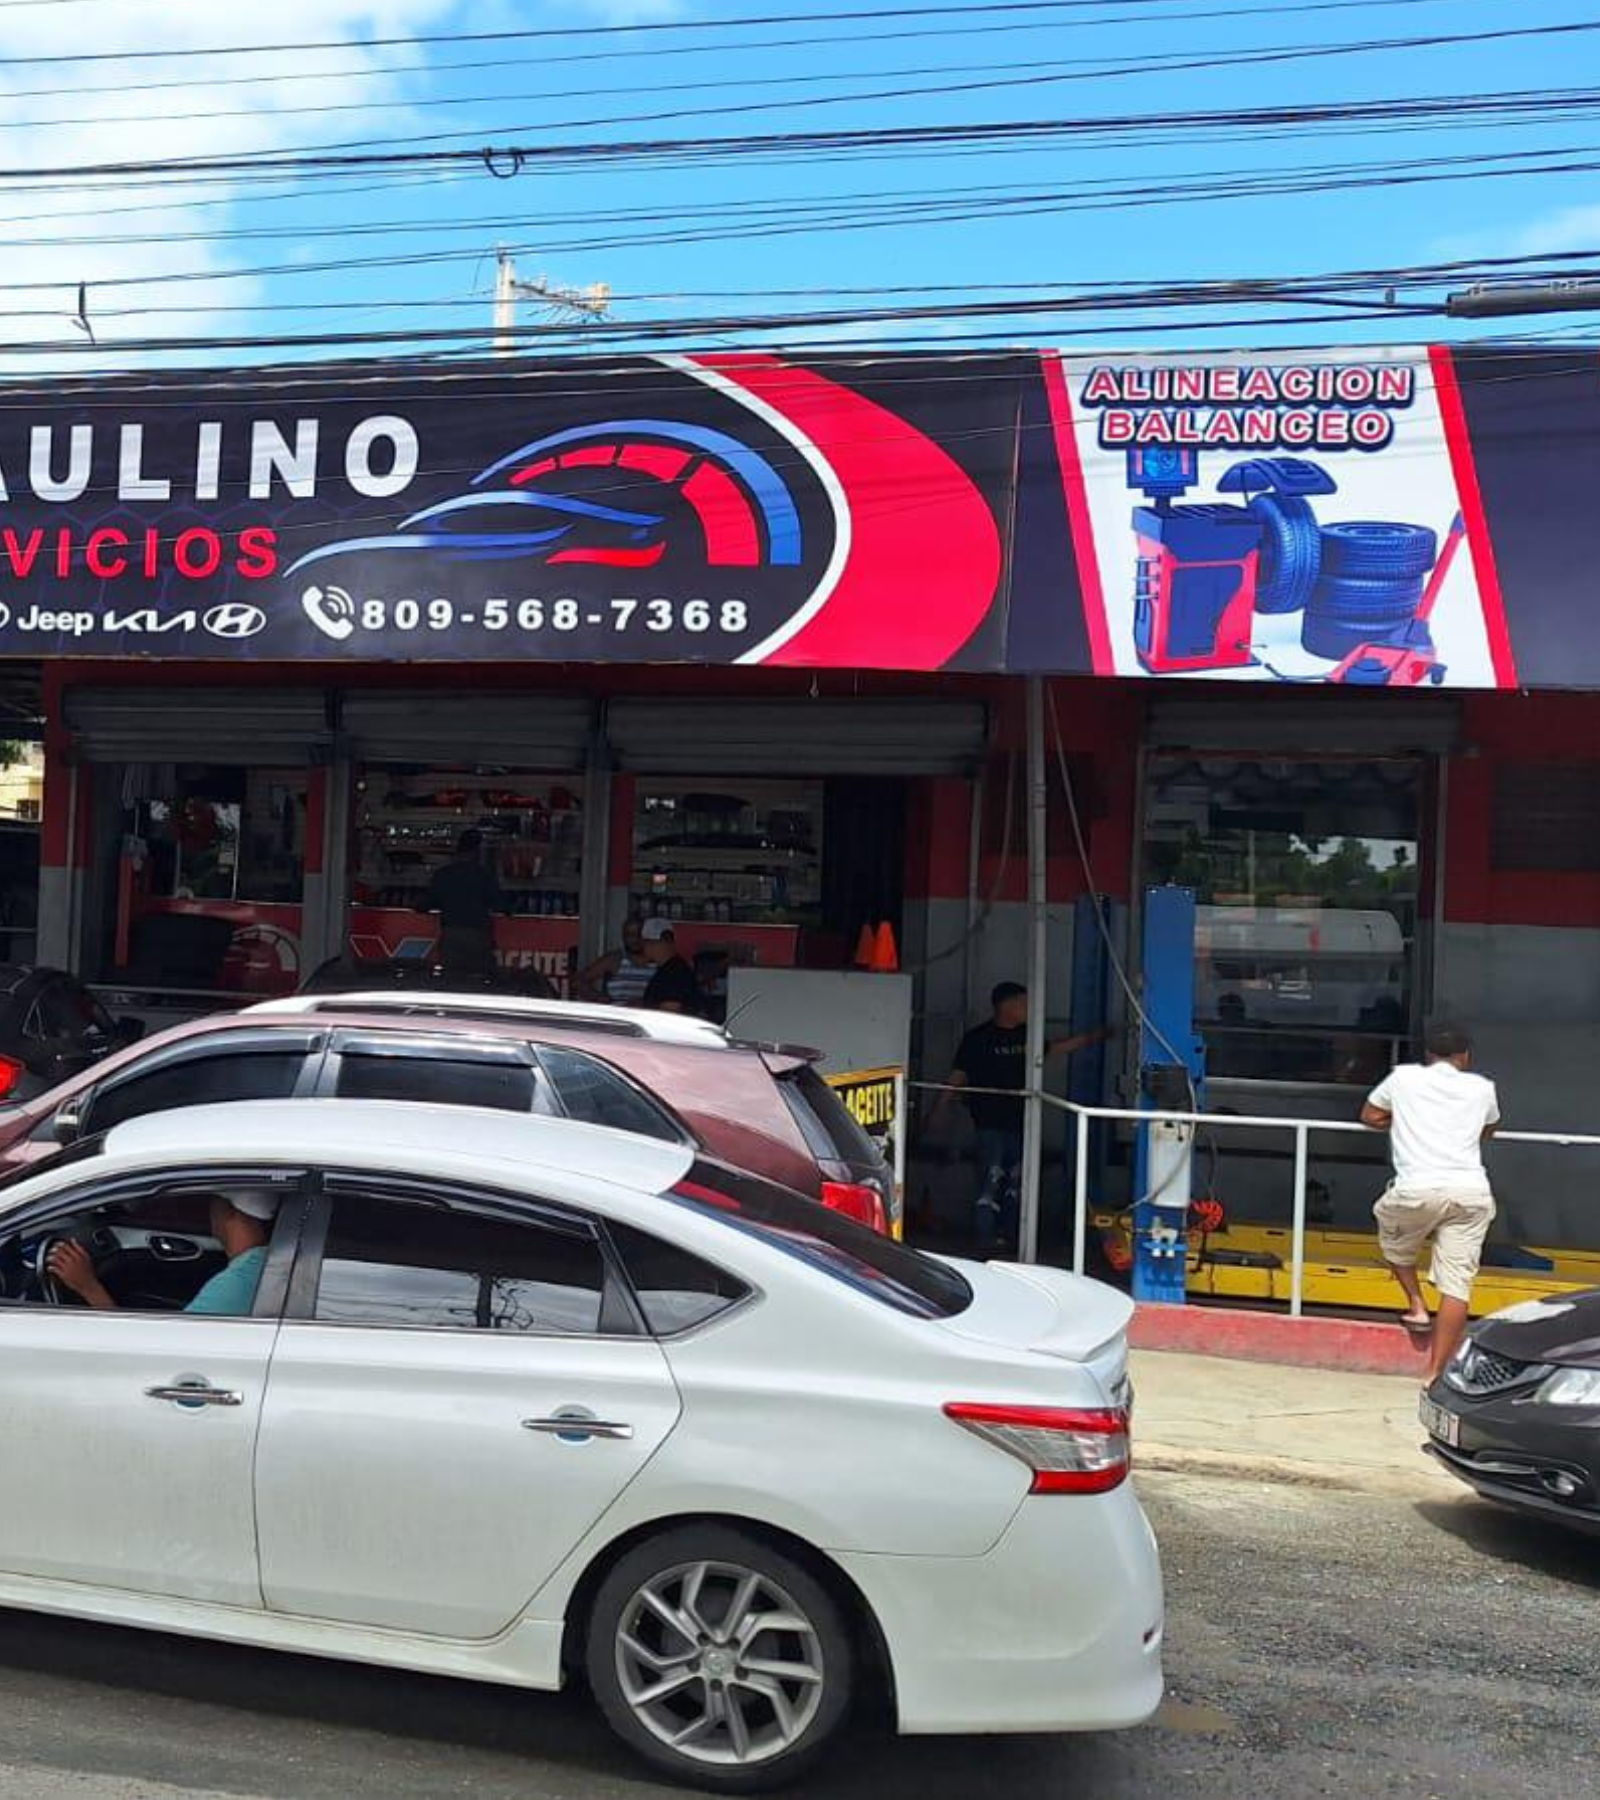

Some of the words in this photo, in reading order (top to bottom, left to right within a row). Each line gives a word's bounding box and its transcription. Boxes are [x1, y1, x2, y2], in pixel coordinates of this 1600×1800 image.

[1085, 366, 1414, 403] ALINEACION
[1102, 409, 1392, 444] BALANCEO
[17, 603, 95, 636] Jeep
[361, 597, 749, 632] 809-568-7368
